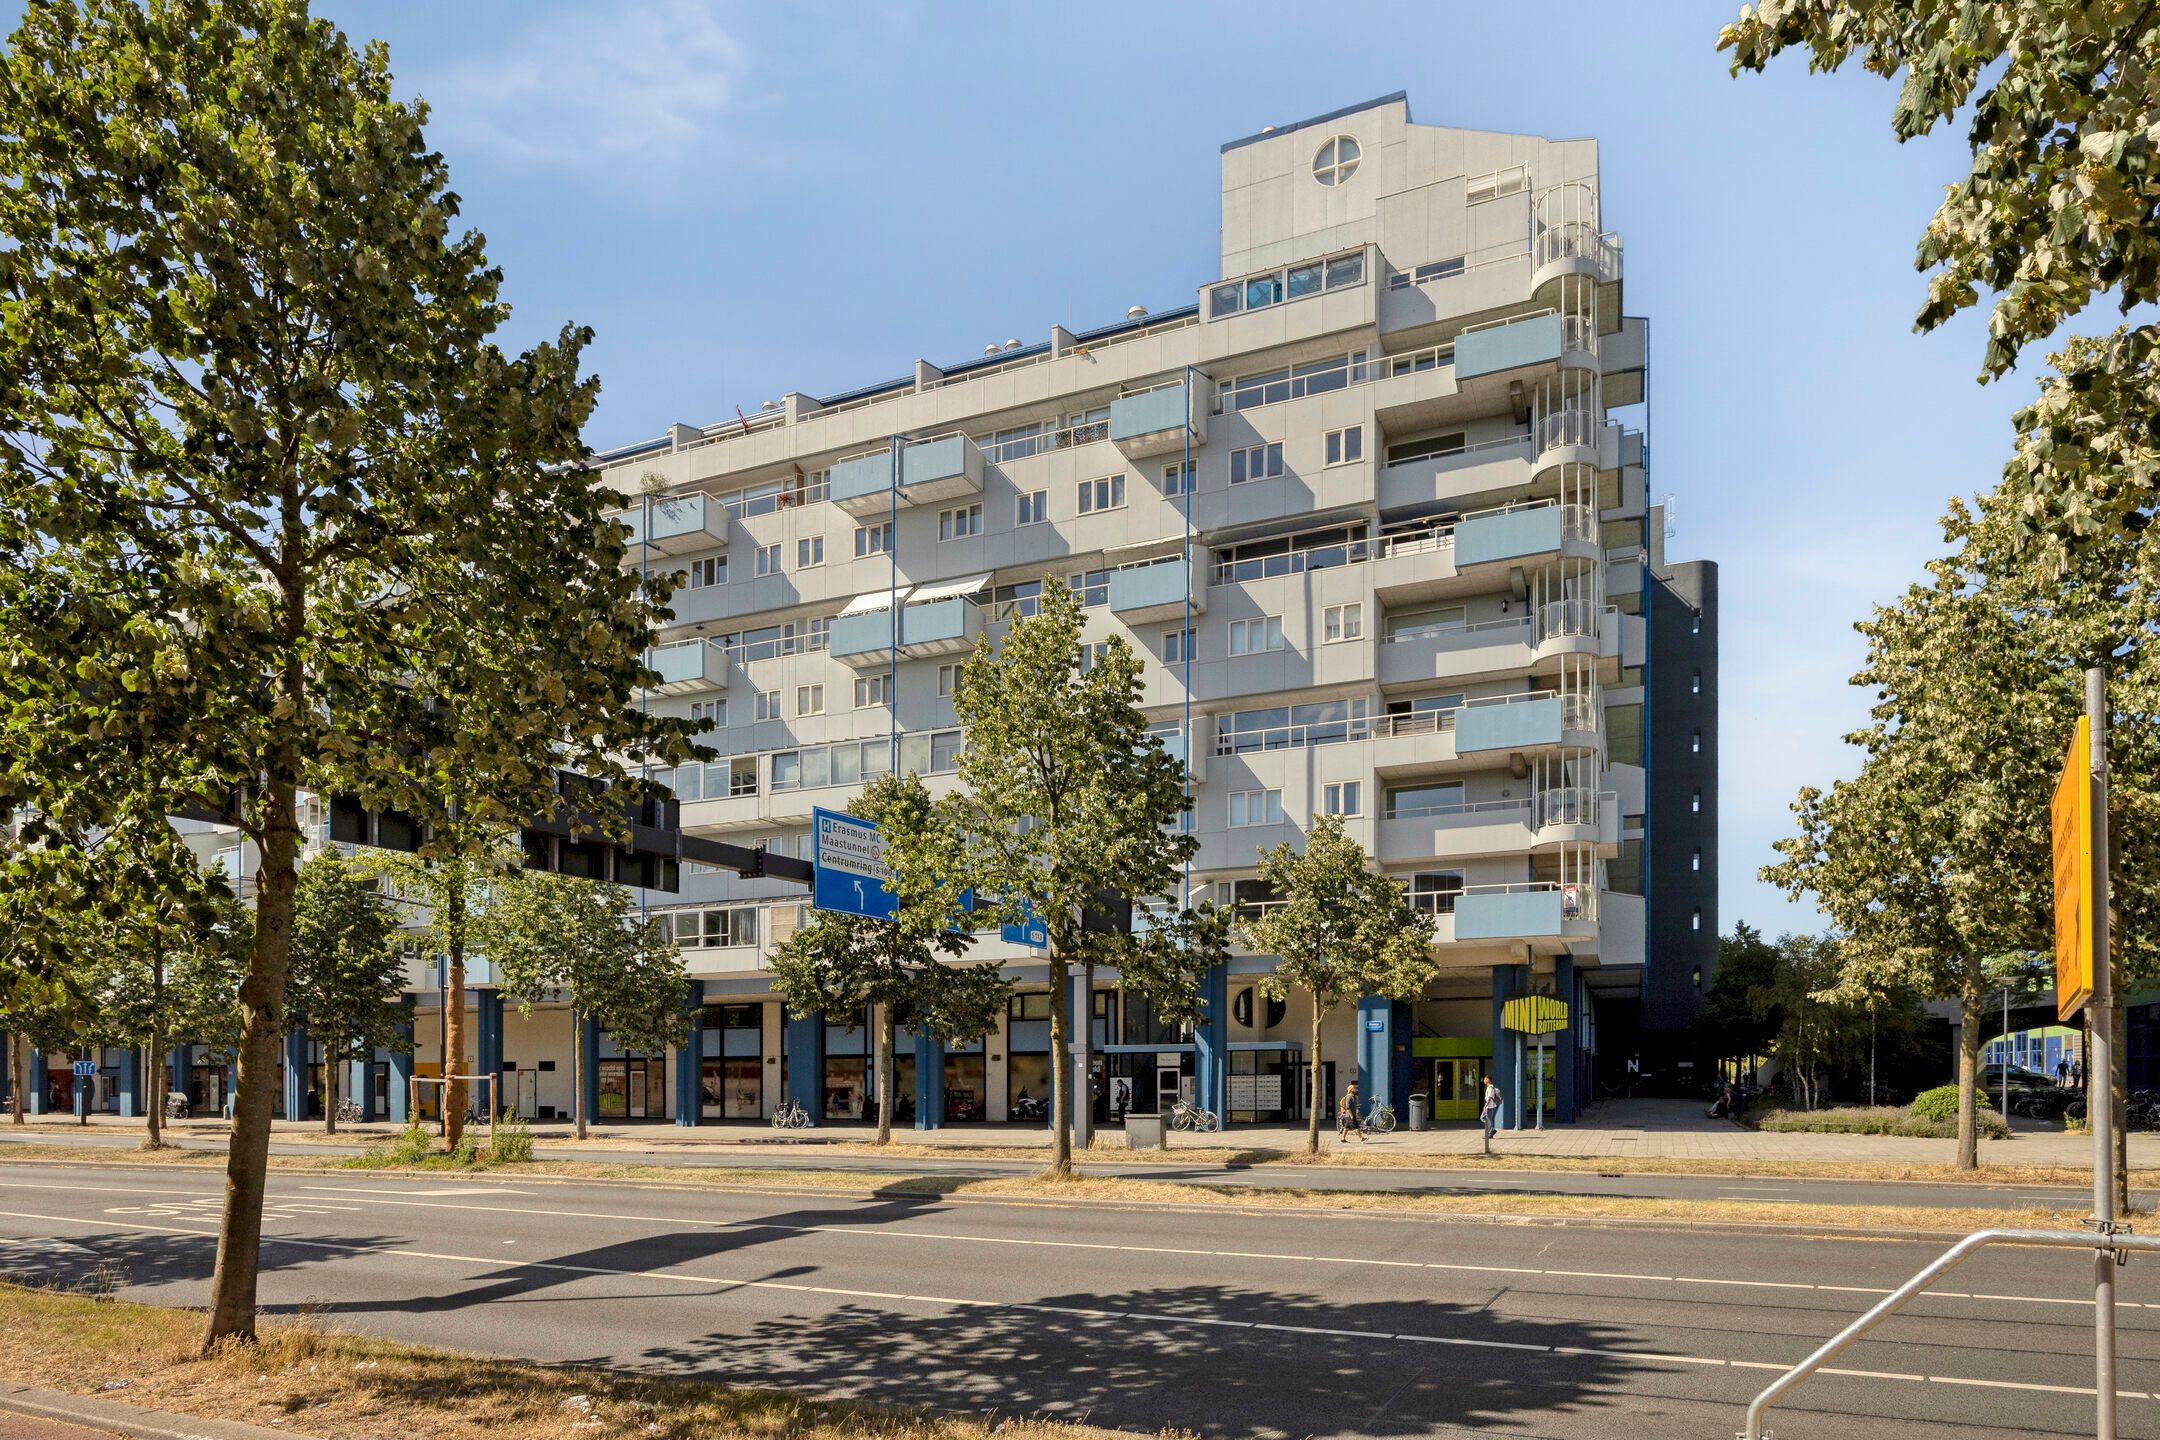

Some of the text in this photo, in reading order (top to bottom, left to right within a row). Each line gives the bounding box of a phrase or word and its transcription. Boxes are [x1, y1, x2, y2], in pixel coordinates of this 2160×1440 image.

[822, 834, 870, 854] Maastunnel
[833, 823, 867, 840] Erasmus
[870, 832, 881, 844] MC
[822, 852, 872, 875] Centrumring
[1505, 995, 1568, 1035] MINI WORLD
[1538, 1020, 1568, 1034] ROTTERDAM
